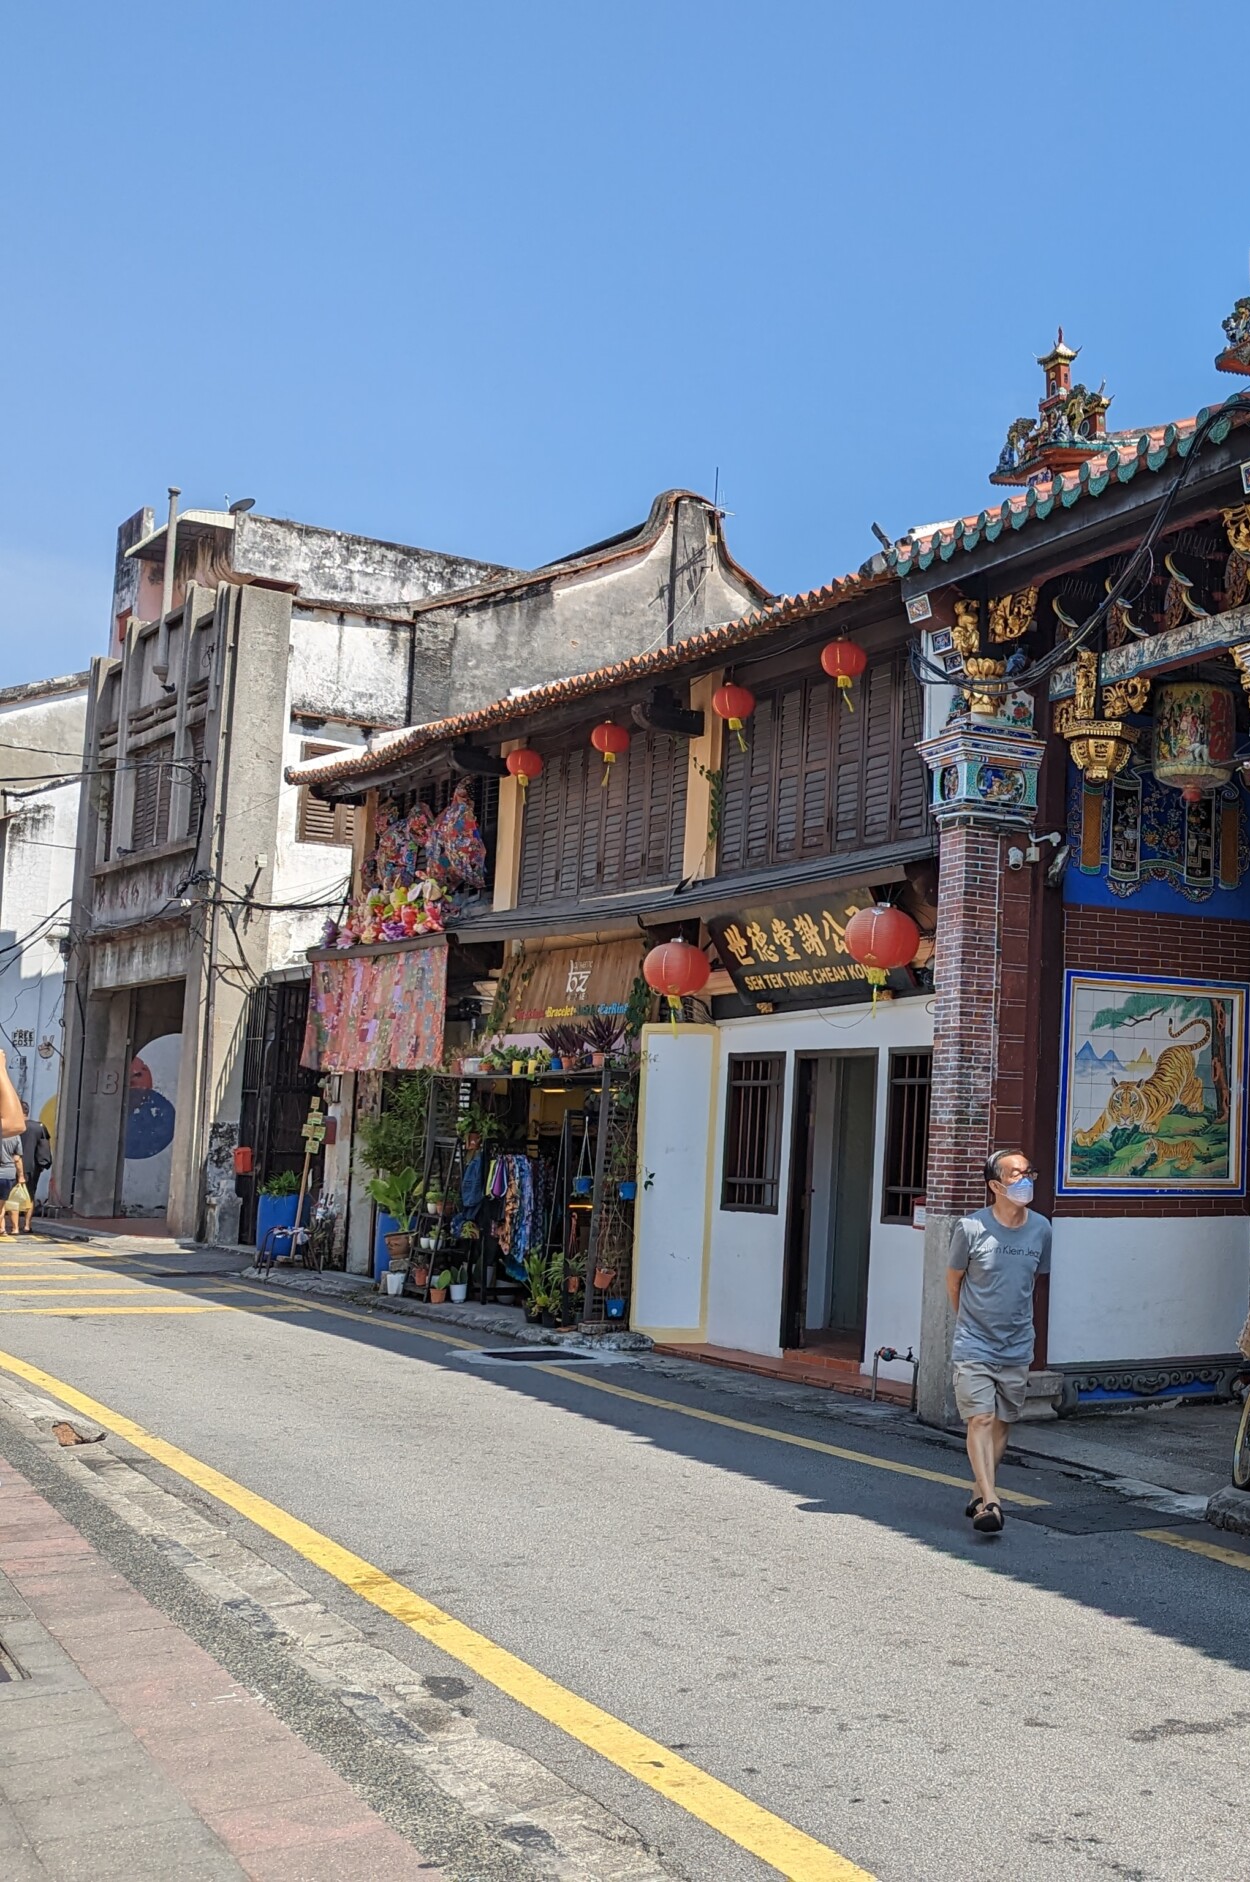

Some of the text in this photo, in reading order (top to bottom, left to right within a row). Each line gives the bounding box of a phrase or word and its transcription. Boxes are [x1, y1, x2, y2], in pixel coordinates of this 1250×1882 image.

[745, 963, 891, 991] SEH TEK TONG CHEAH KONI
[13, 1032, 33, 1040] FREE
[13, 1039, 33, 1047] COST
[1003, 1244, 1024, 1256] Klein
